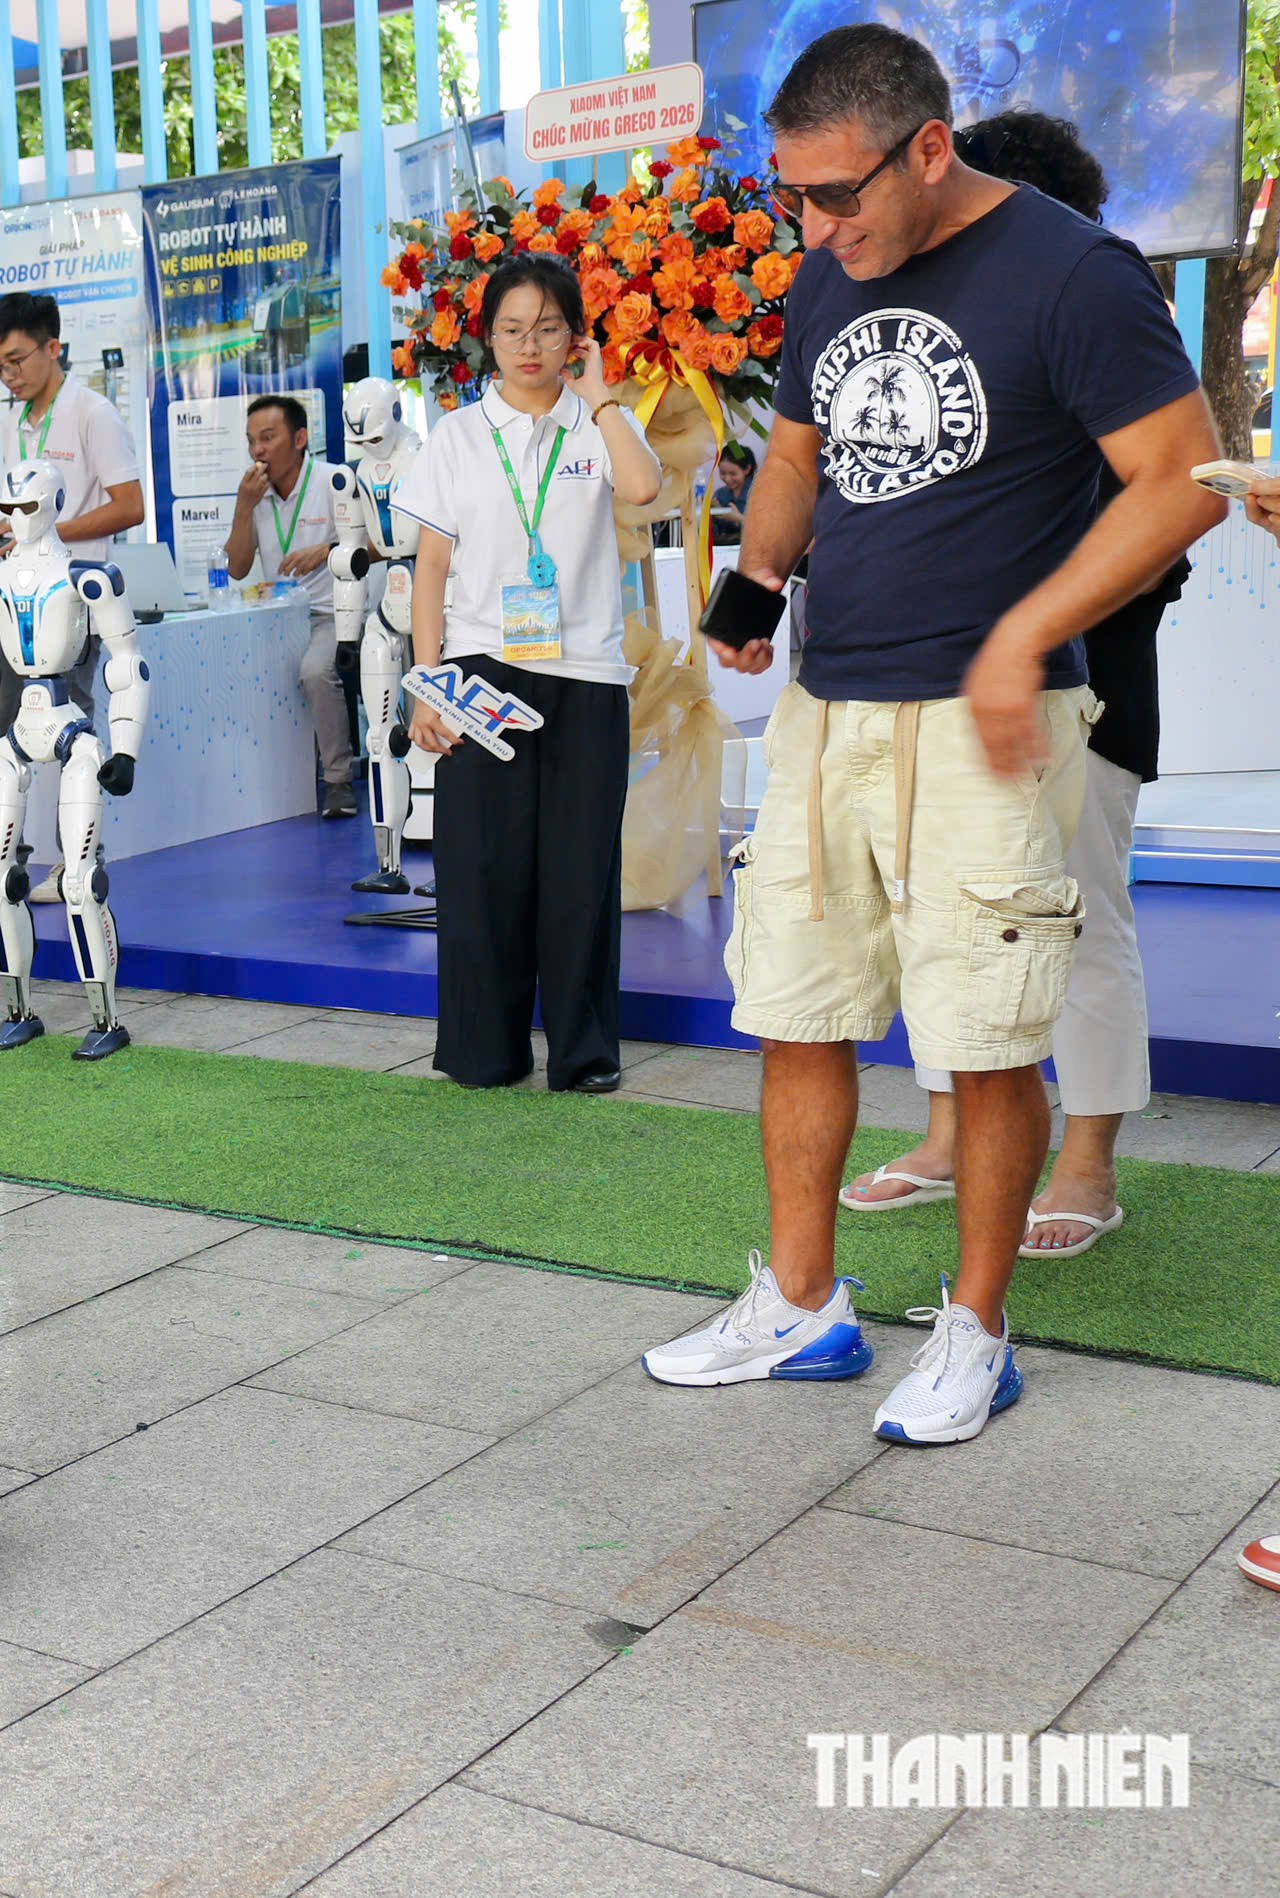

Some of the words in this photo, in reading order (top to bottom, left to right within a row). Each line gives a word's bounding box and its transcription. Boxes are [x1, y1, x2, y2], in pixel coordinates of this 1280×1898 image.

[570, 94, 606, 114] XIAOMI
[608, 87, 628, 108] VIỆT
[632, 83, 656, 103] NAM
[532, 123, 566, 149] CHÚC
[570, 117, 610, 143] MỪNG
[614, 110, 655, 136] GRECO
[660, 103, 695, 129] 2026
[159, 226, 211, 250] ROBOT
[214, 222, 238, 246] TỰ
[240, 215, 287, 240] HÀNH
[81, 249, 134, 274] HÀNH
[161, 255, 179, 277] VỆ
[181, 255, 214, 272] SINH
[217, 247, 254, 267] CÔNG
[257, 240, 308, 262] NGHIỆP
[895, 320, 974, 437] ISLAND
[176, 412, 202, 426] Mira
[182, 507, 220, 522] Marvel
[417, 670, 538, 733] AEF
[442, 706, 463, 723] KINH
[492, 742, 509, 757] THU
[101, 910, 116, 967] EHOANG
